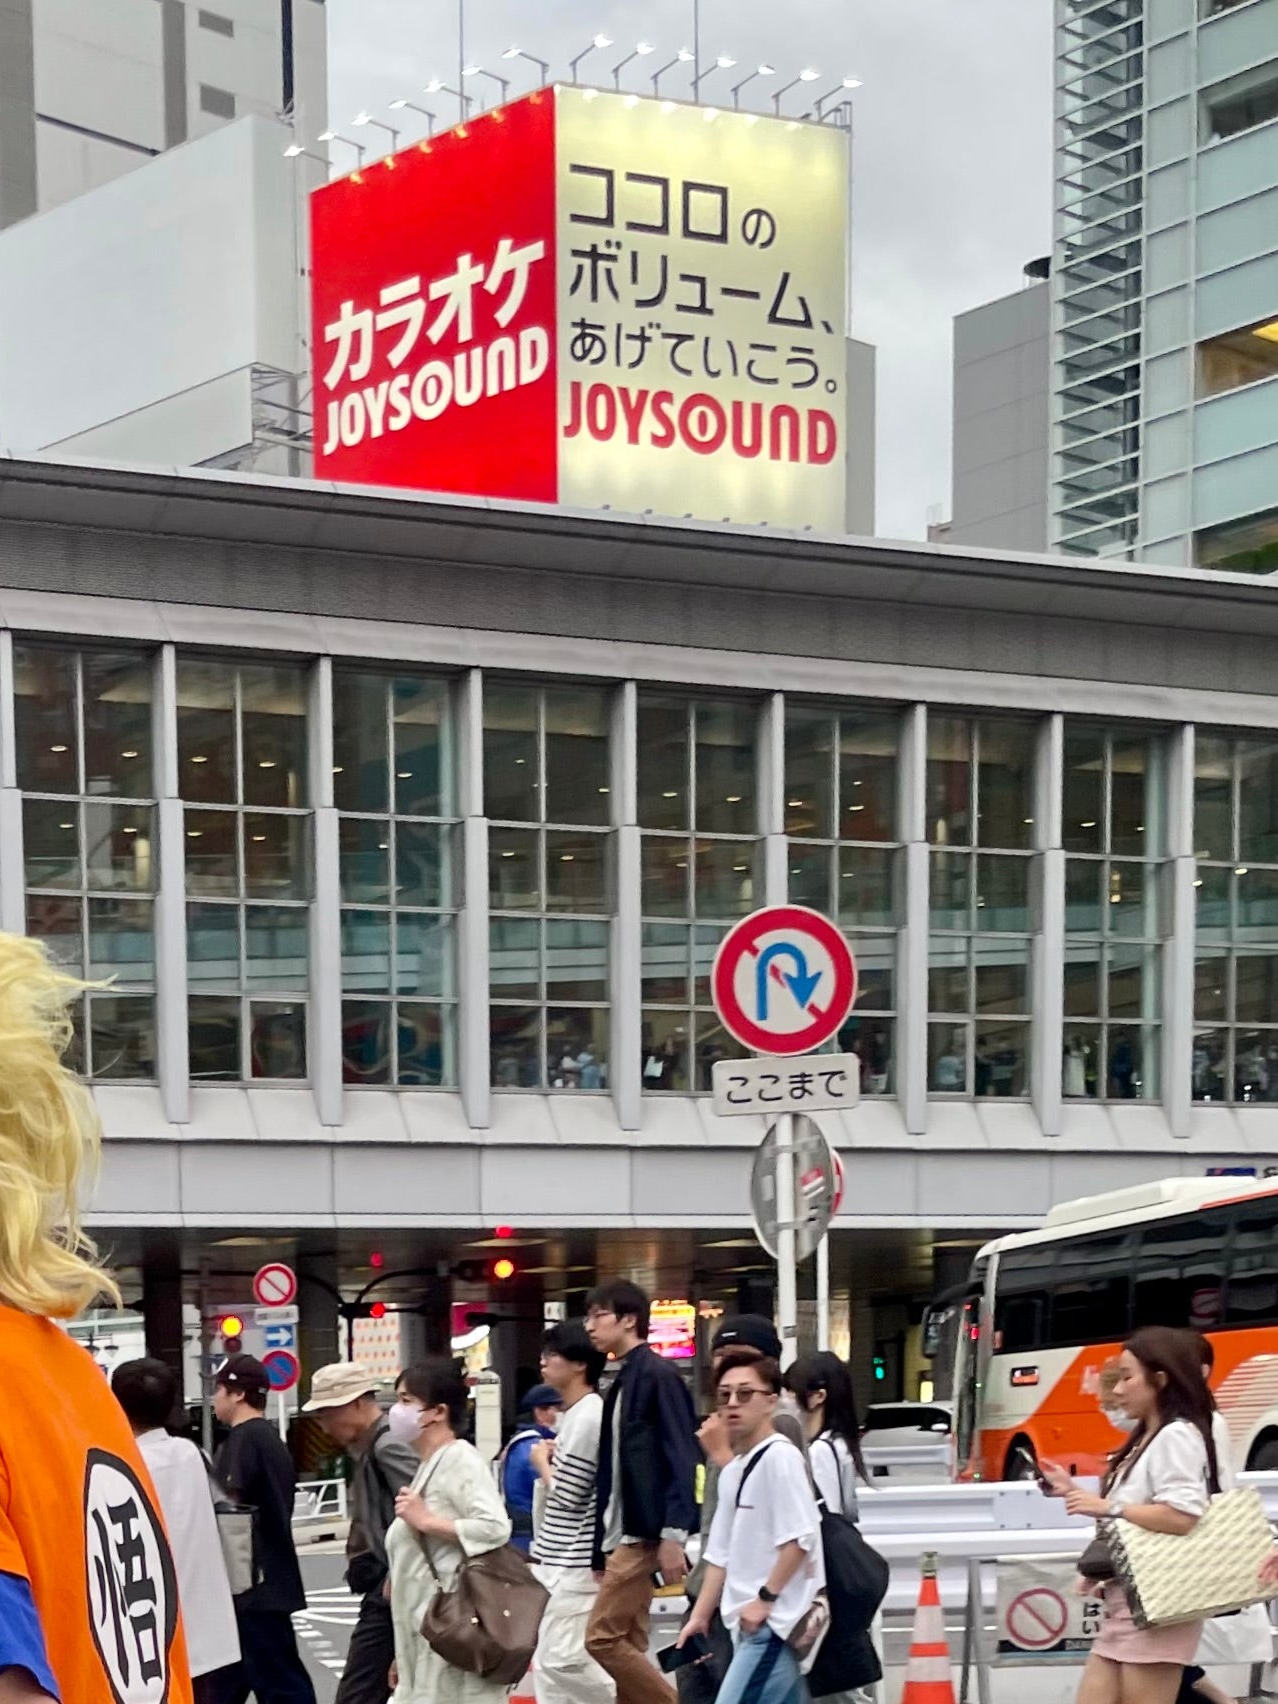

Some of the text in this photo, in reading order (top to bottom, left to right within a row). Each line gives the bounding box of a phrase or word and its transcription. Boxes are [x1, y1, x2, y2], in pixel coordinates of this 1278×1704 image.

[568, 163, 777, 249] ココロの
[322, 238, 545, 391] カラオケ
[568, 240, 834, 334] ボリューム、
[322, 326, 550, 456] JOYSOUND
[568, 317, 838, 395] あげていこう。
[563, 381, 837, 465] JOYSOUND
[726, 1070, 848, 1104] ここまで
[91, 1496, 163, 1689] 悟
